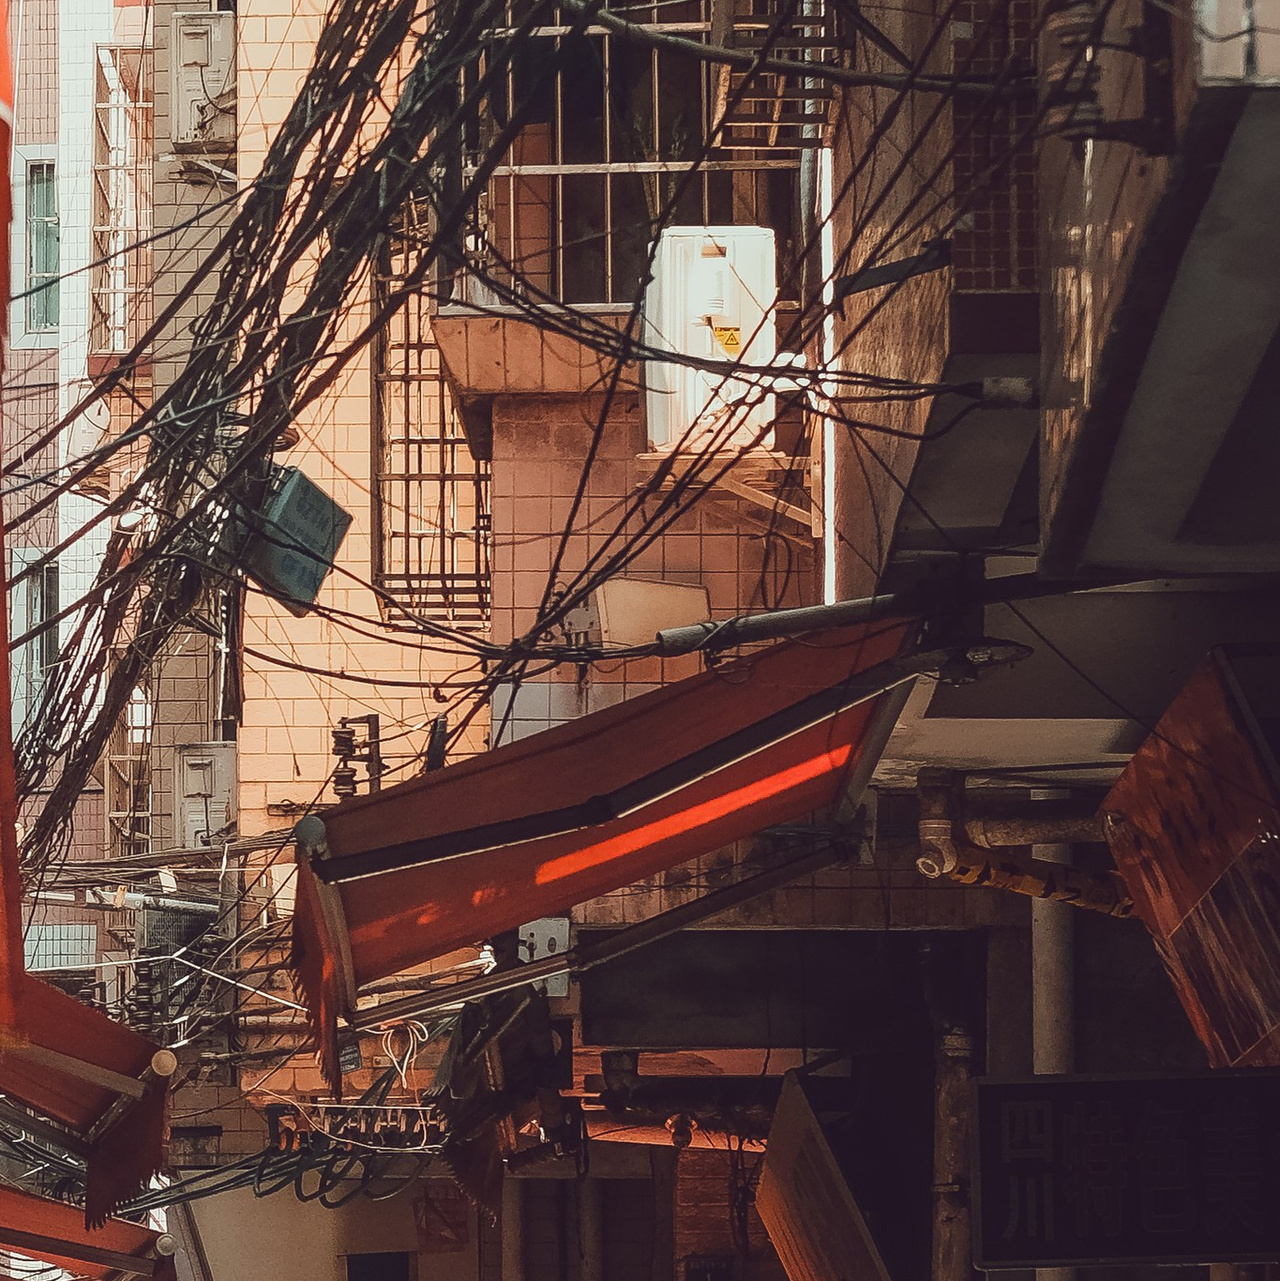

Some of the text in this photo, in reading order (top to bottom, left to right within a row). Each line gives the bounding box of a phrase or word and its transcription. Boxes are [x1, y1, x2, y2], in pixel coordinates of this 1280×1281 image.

[1000, 1100, 1056, 1242] 四川
[1063, 1095, 1280, 1239] 特色美
